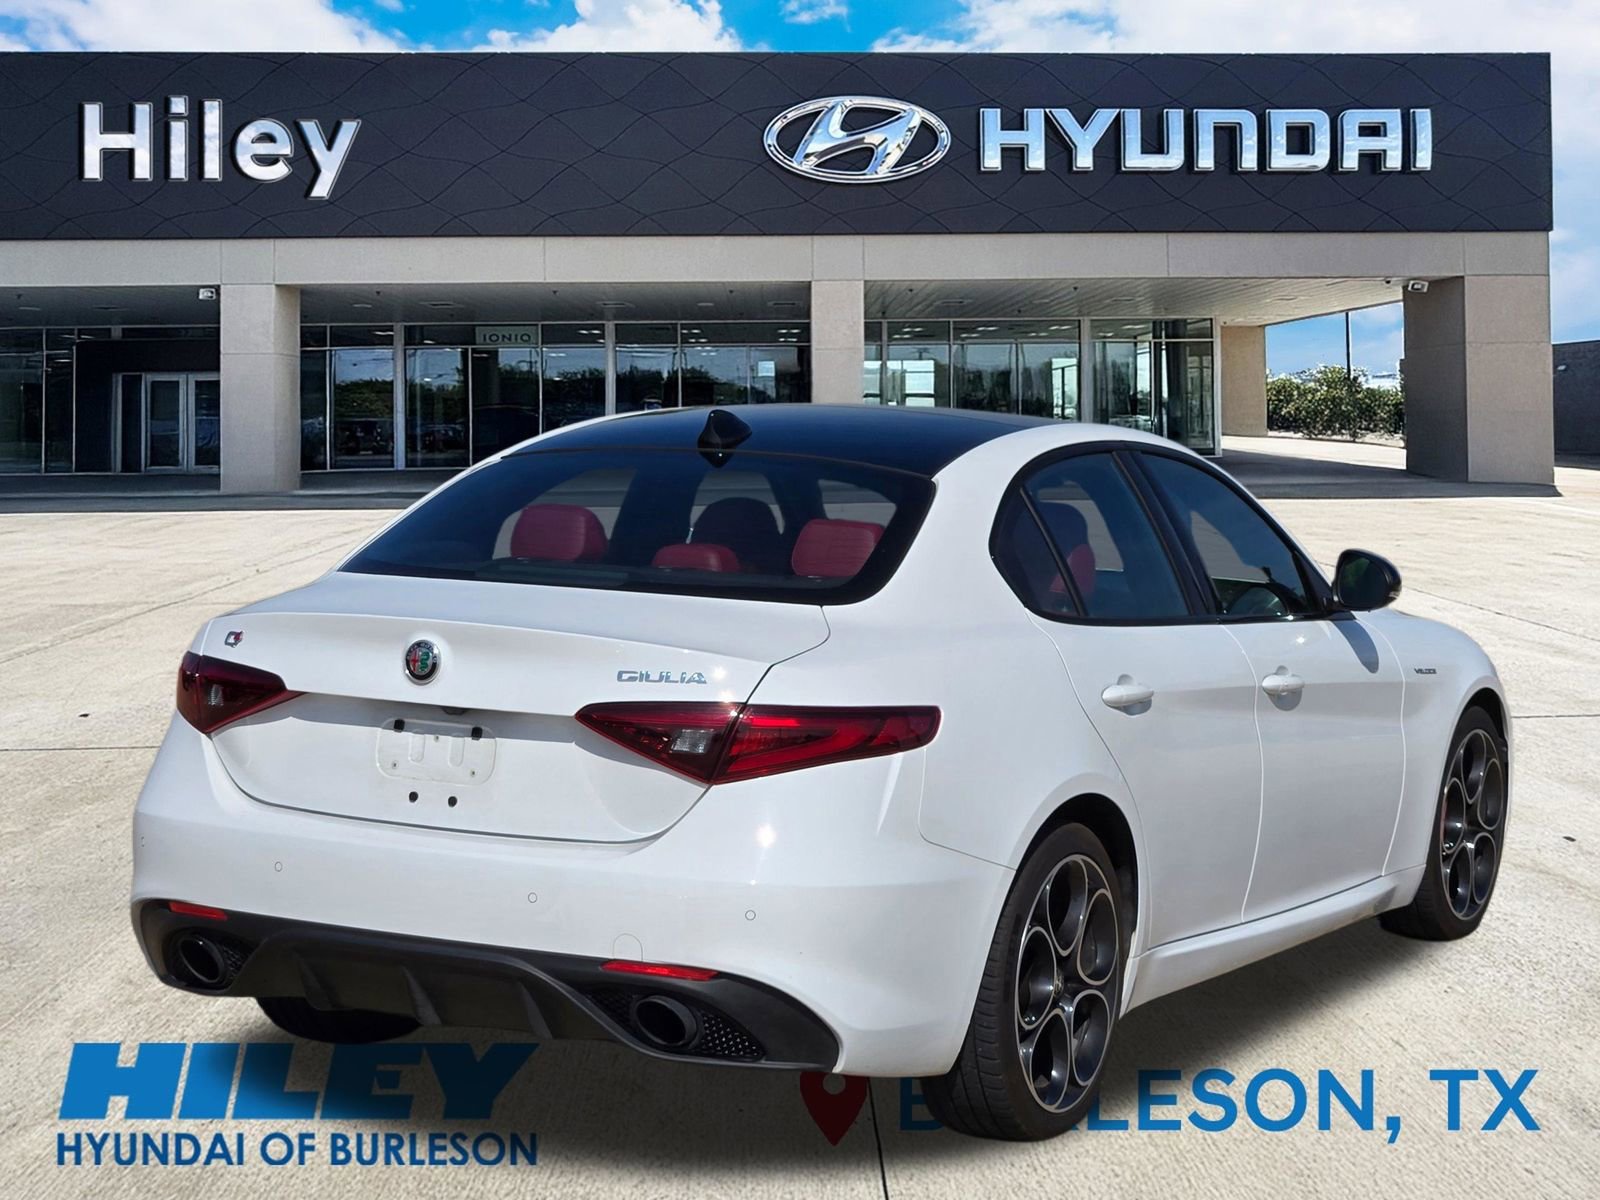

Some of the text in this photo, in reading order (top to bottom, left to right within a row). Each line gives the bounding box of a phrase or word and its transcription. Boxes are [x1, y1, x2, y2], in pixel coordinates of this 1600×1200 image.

[80, 95, 361, 199] Hiley
[979, 107, 1431, 172] HYUNDAI
[616, 669, 708, 685] GIULIA
